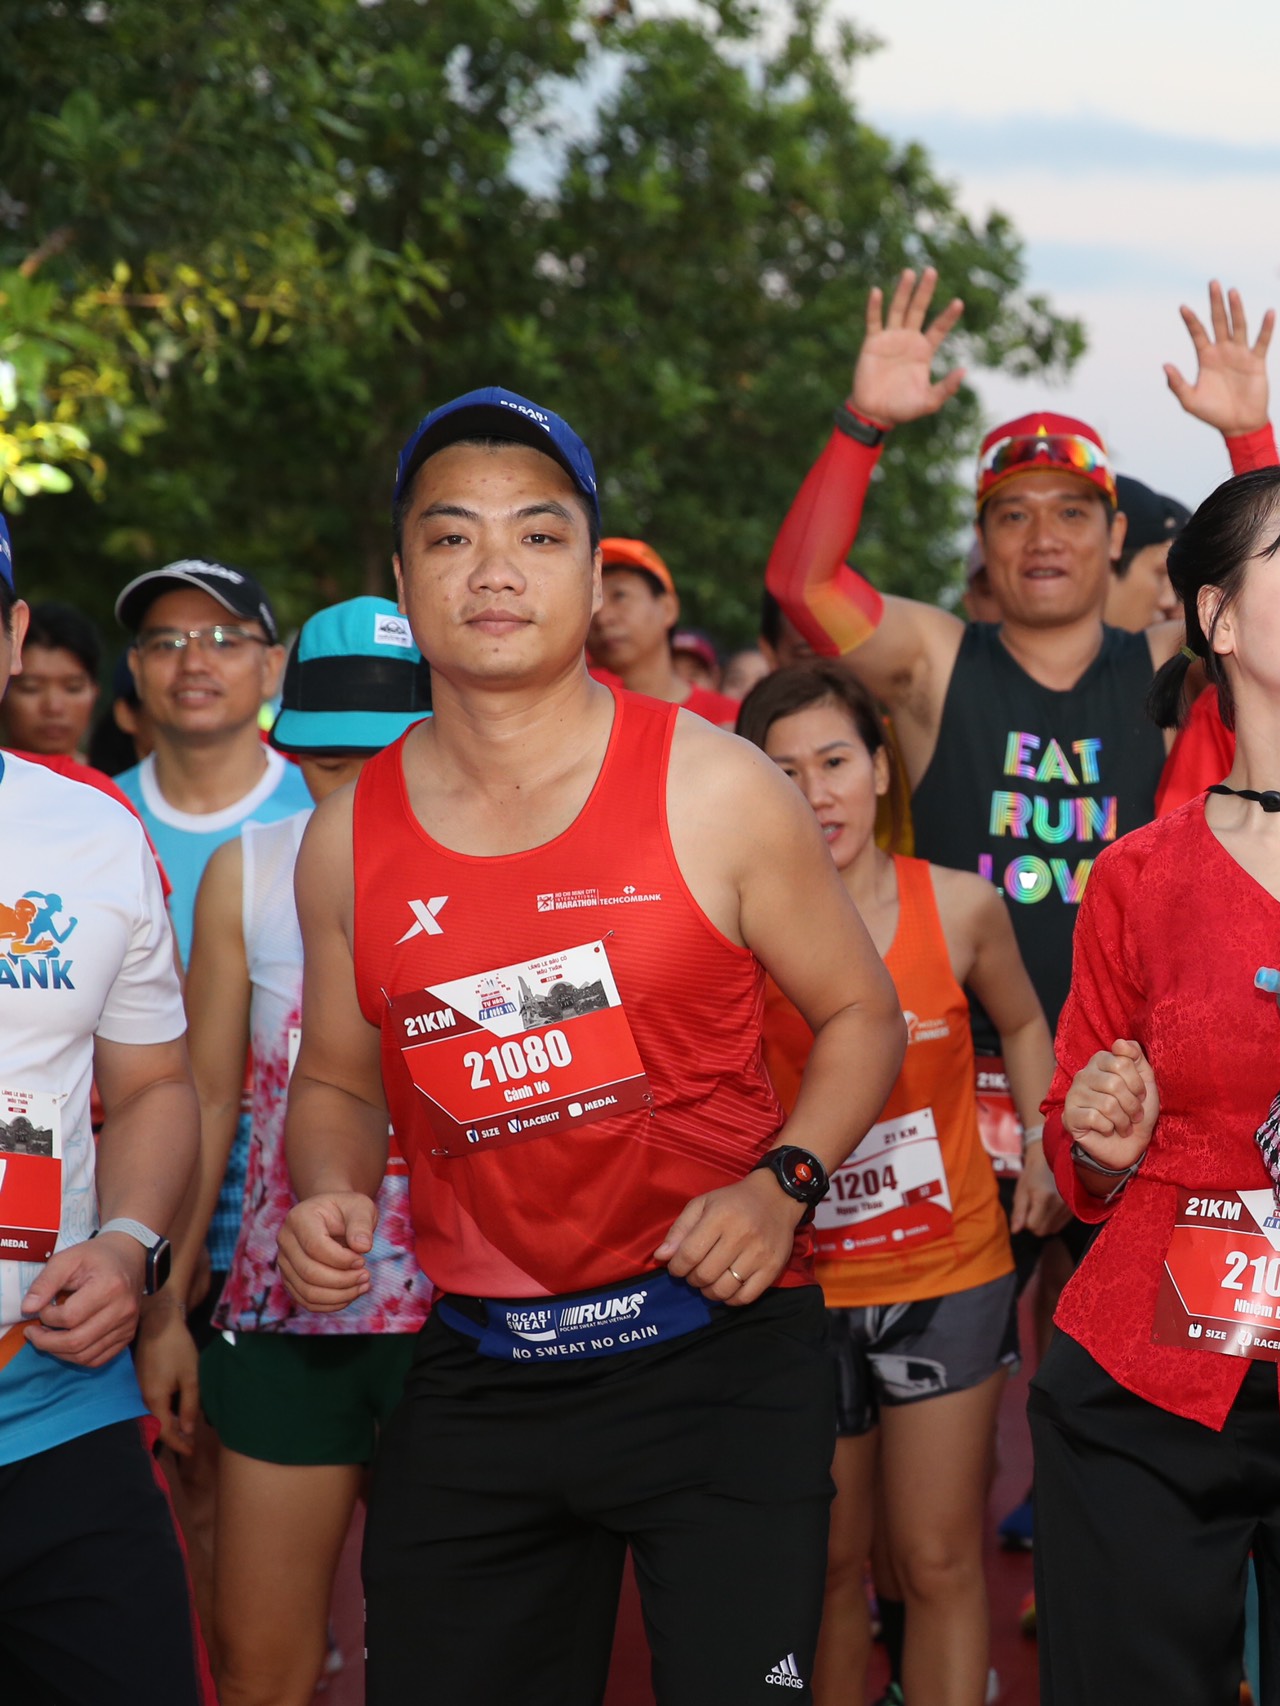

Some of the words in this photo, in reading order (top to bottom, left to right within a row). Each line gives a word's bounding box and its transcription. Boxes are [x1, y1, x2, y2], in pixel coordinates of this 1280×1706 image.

[1003, 731, 1103, 786] EAT
[989, 790, 1118, 845] RUN
[977, 853, 1095, 905] LOV
[555, 898, 598, 910] MARATHON
[599, 893, 662, 906] TECHCOMBANK
[404, 1007, 457, 1038] 21KM
[463, 1028, 573, 1091] 21080
[584, 1095, 618, 1112] MEDAL
[522, 1111, 561, 1129] RACEKIT
[481, 1126, 501, 1139] SIZE
[899, 1126, 918, 1139] KM
[1184, 1197, 1243, 1222] 21KM
[0, 1238, 29, 1250] MEDAL
[506, 1310, 551, 1322] POCARI
[608, 1314, 632, 1324] VIETNAM
[507, 1319, 548, 1331] SWEAT
[512, 1347, 532, 1360] NO
[535, 1341, 586, 1358] SWEAT
[590, 1336, 614, 1350] NO
[618, 1324, 659, 1344] GAIN
[1205, 1328, 1227, 1340] SIZE
[765, 1672, 804, 1689] adidas
